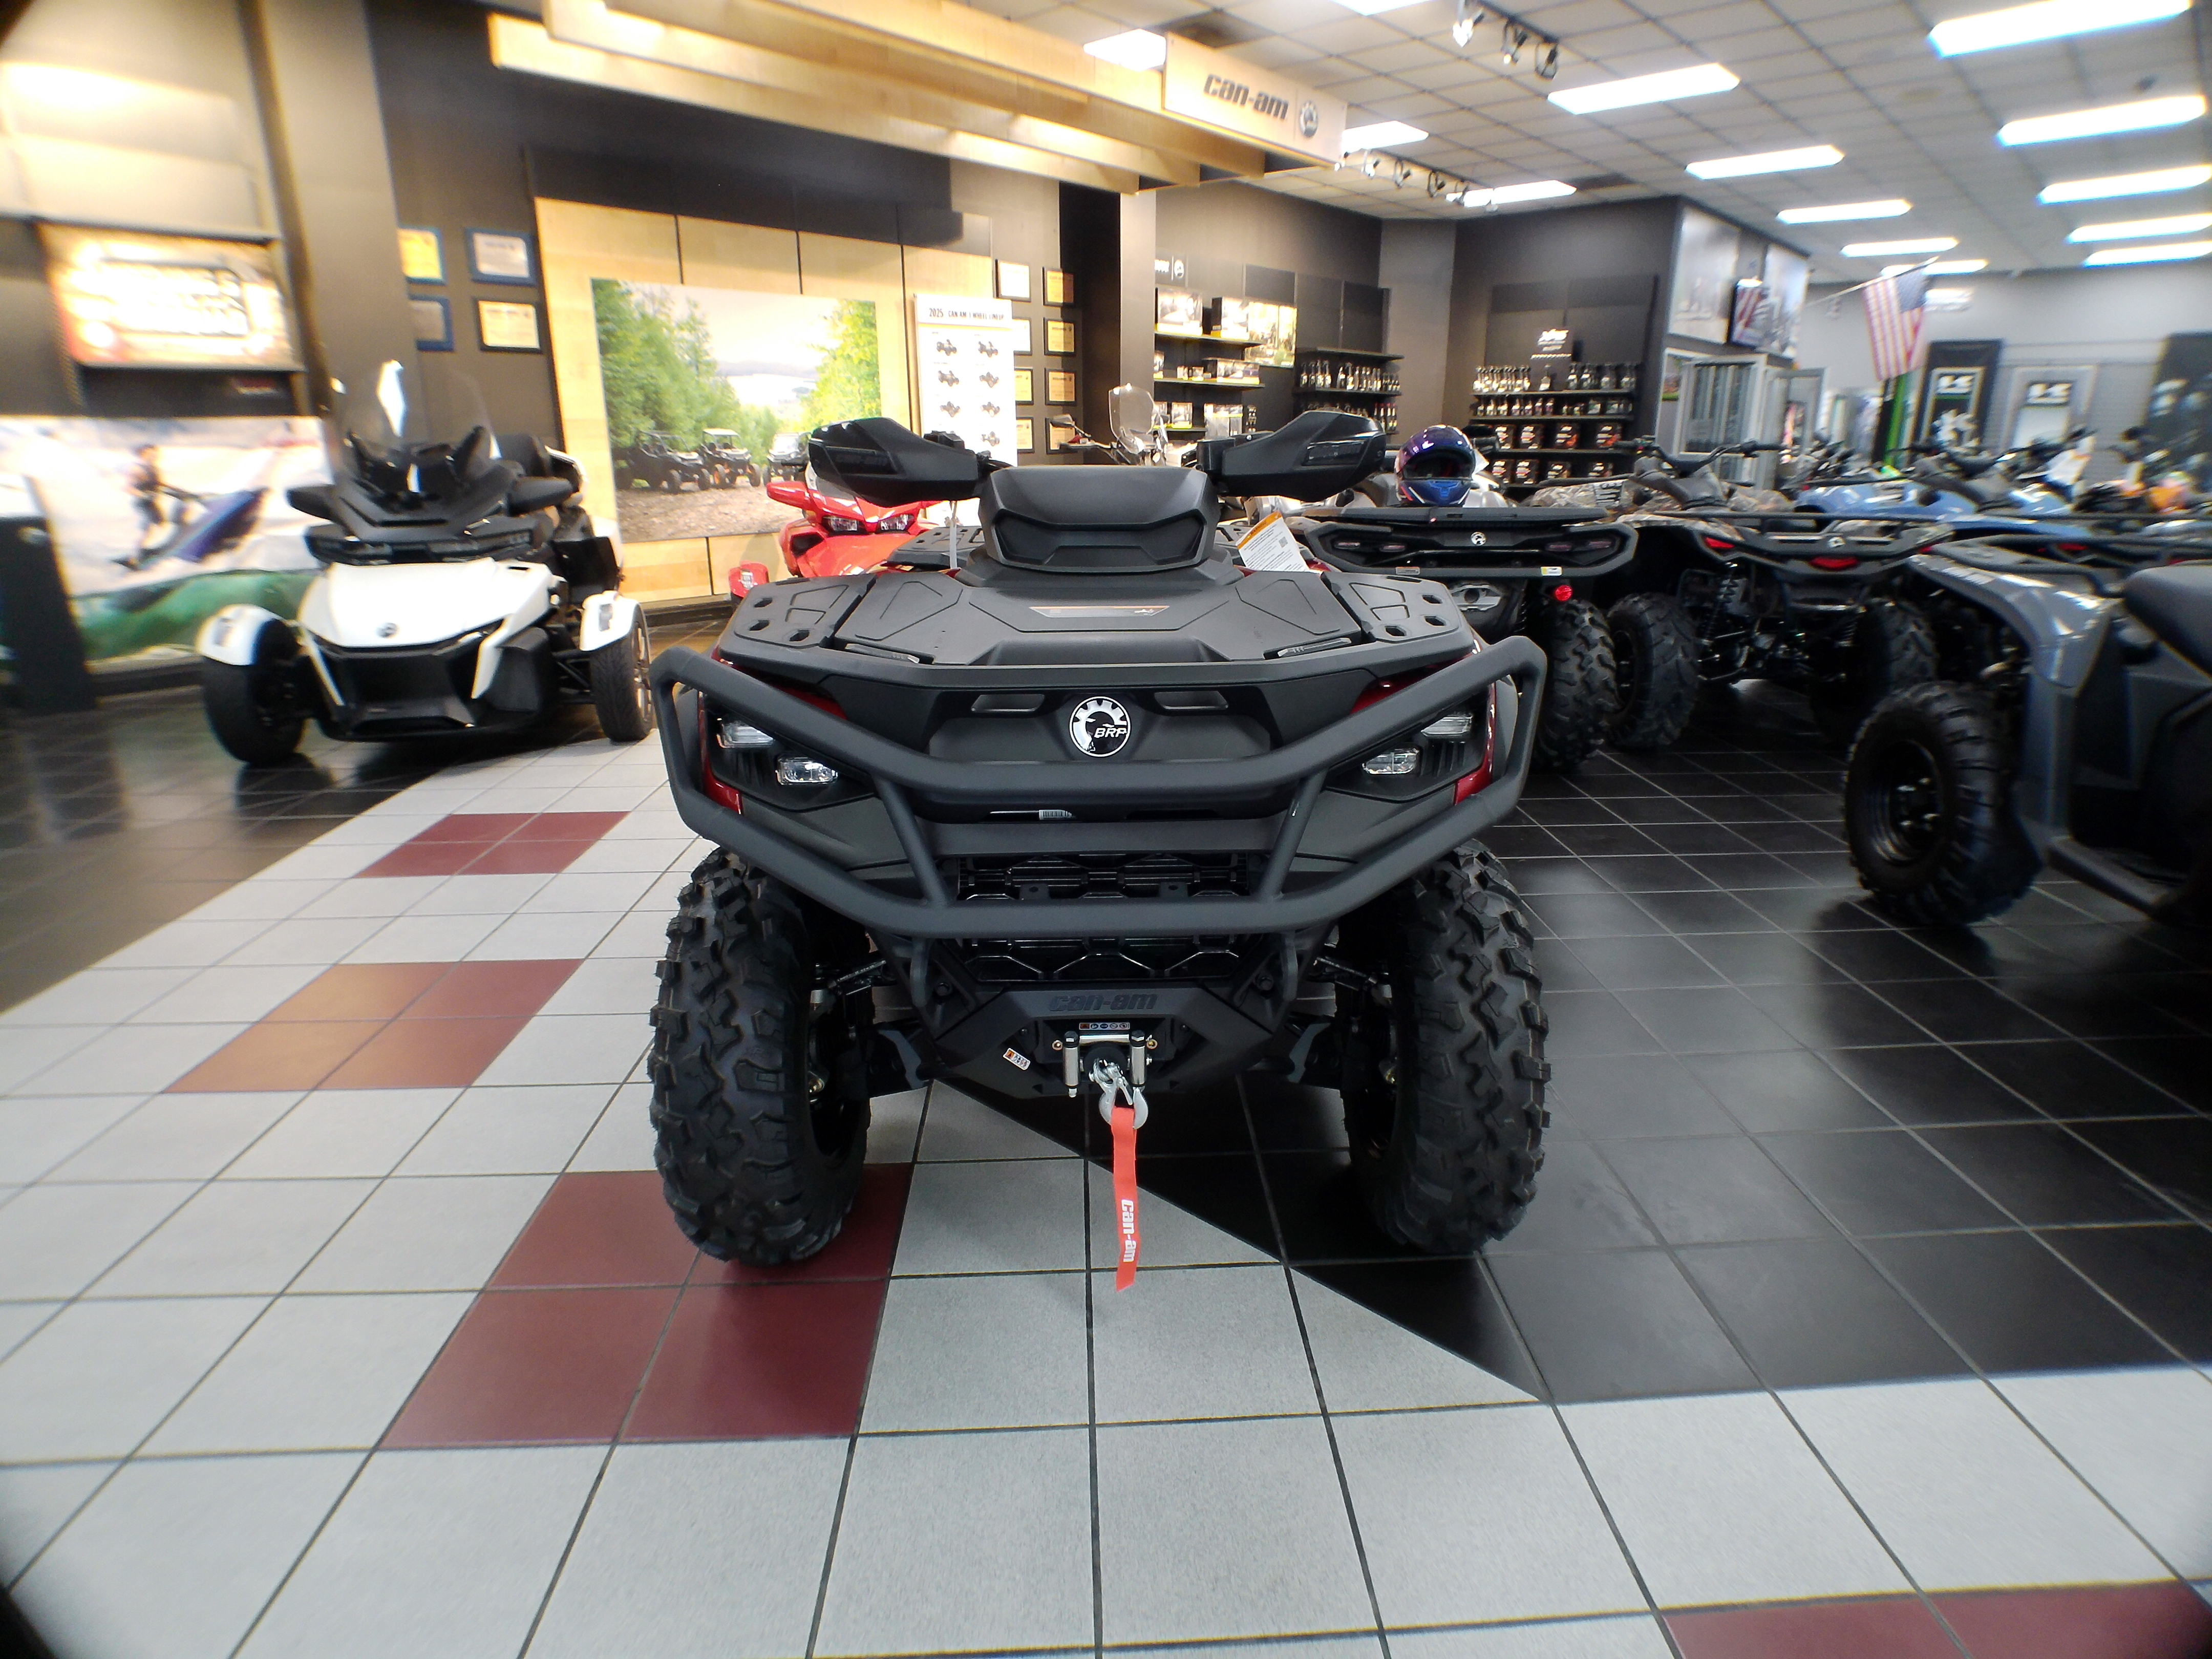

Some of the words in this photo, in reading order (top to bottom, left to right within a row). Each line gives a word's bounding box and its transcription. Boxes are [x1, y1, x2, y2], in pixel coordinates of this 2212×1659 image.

[1204, 74, 1289, 120] can-am
[929, 307, 944, 318] 2025
[1094, 728, 1127, 738] BRP
[1049, 993, 1158, 1012] can-am
[1121, 1199, 1137, 1263] can-am
